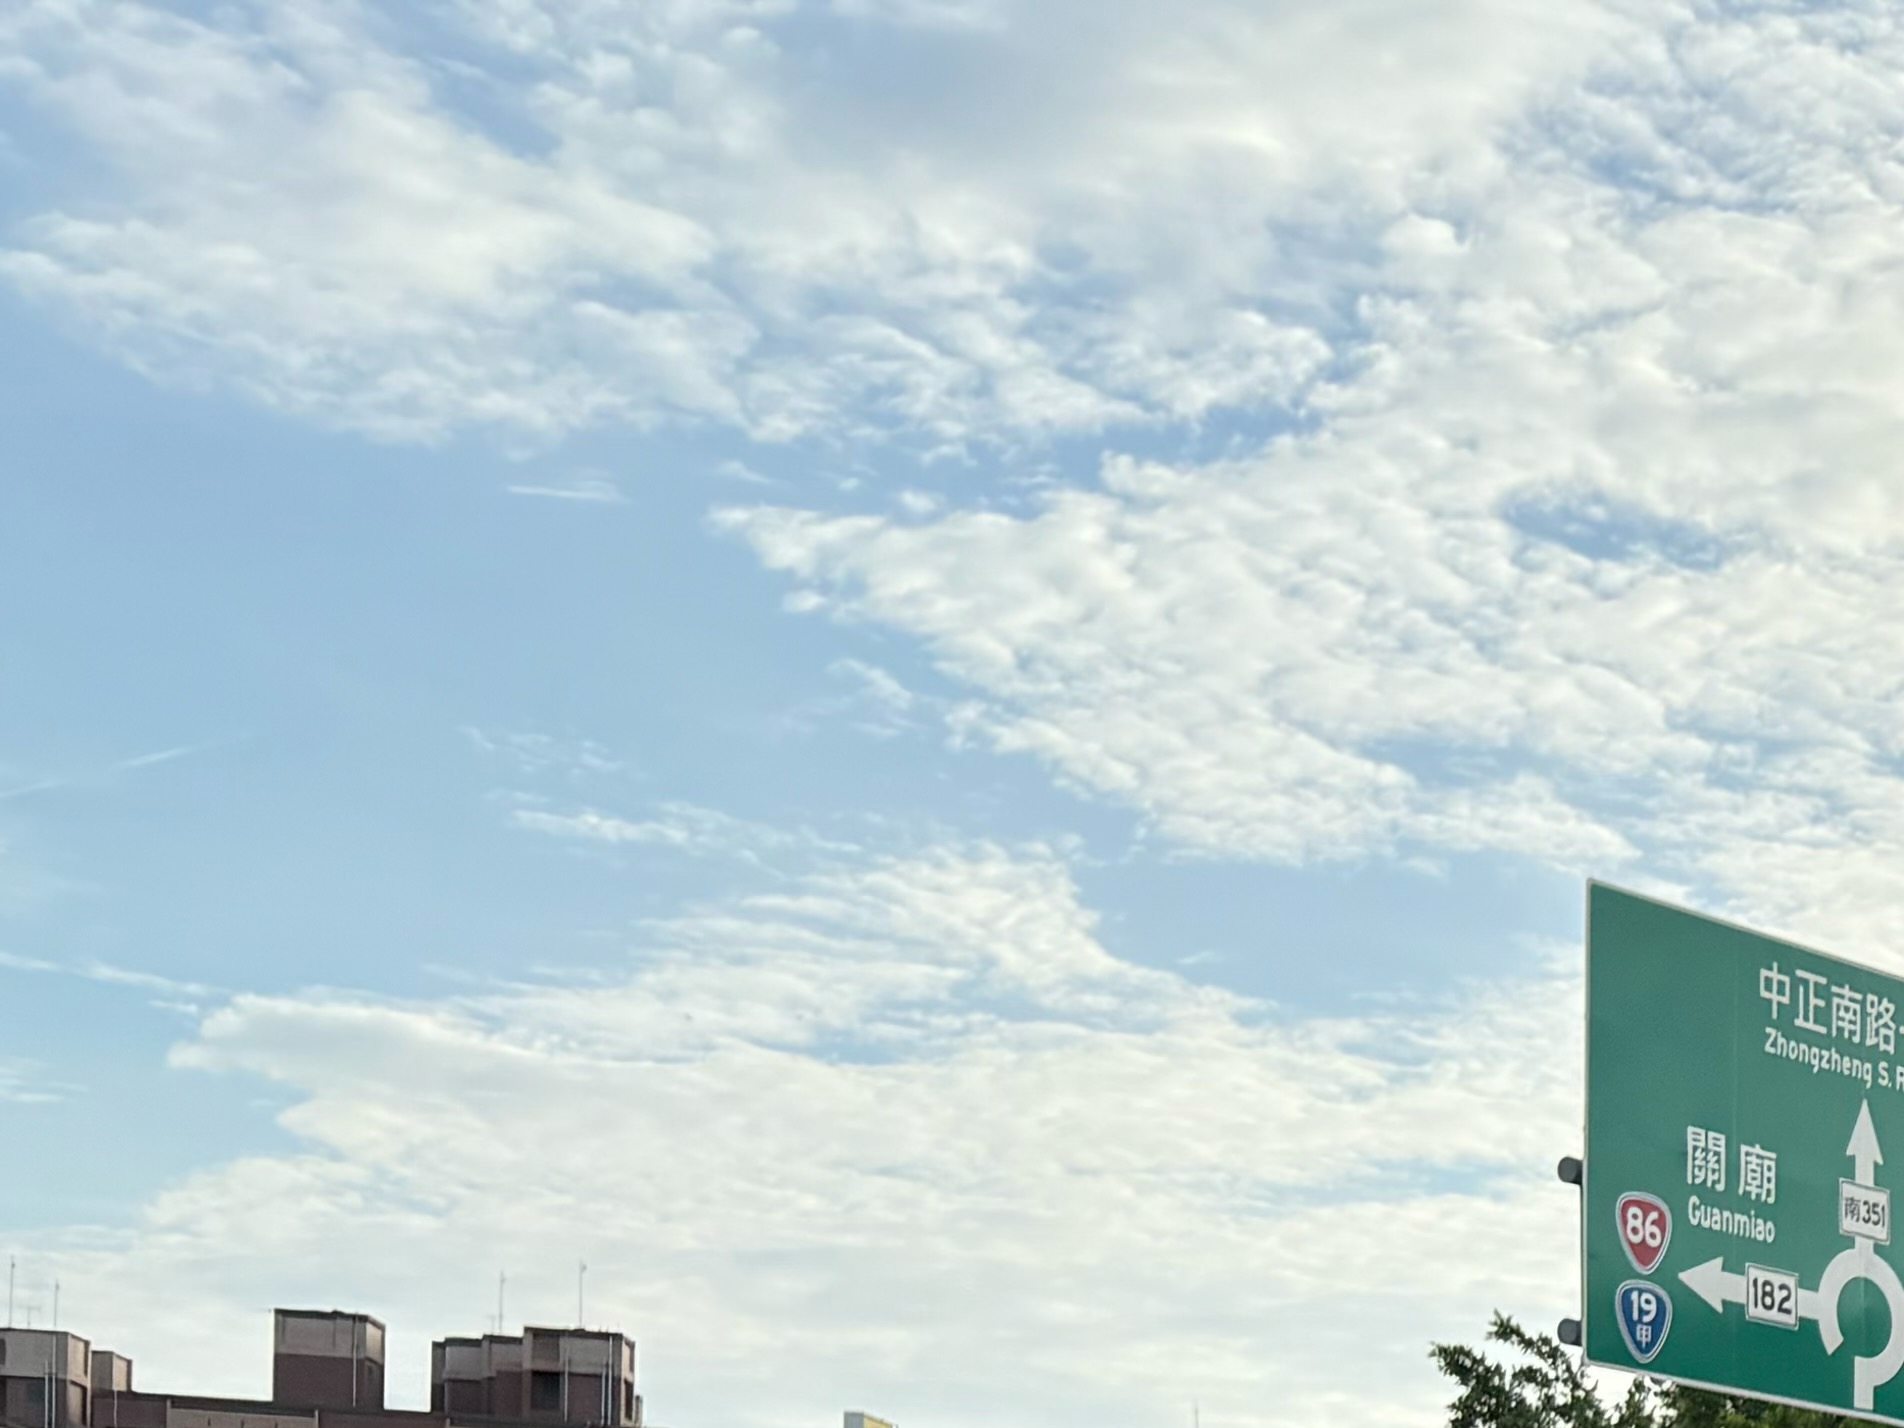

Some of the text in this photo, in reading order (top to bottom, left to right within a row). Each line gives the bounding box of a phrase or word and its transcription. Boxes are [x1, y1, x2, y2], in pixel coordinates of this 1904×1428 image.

[1764, 1027, 1873, 1089] Zhongzheng
[1878, 1063, 1892, 1090] S.
[1686, 1124, 1777, 1206] 關廟
[1625, 1204, 1662, 1245] 86
[1687, 1195, 1776, 1244] Guanmiao
[1843, 1195, 1886, 1228] 南351
[1630, 1289, 1657, 1323] 19
[1751, 1276, 1793, 1316] 182
